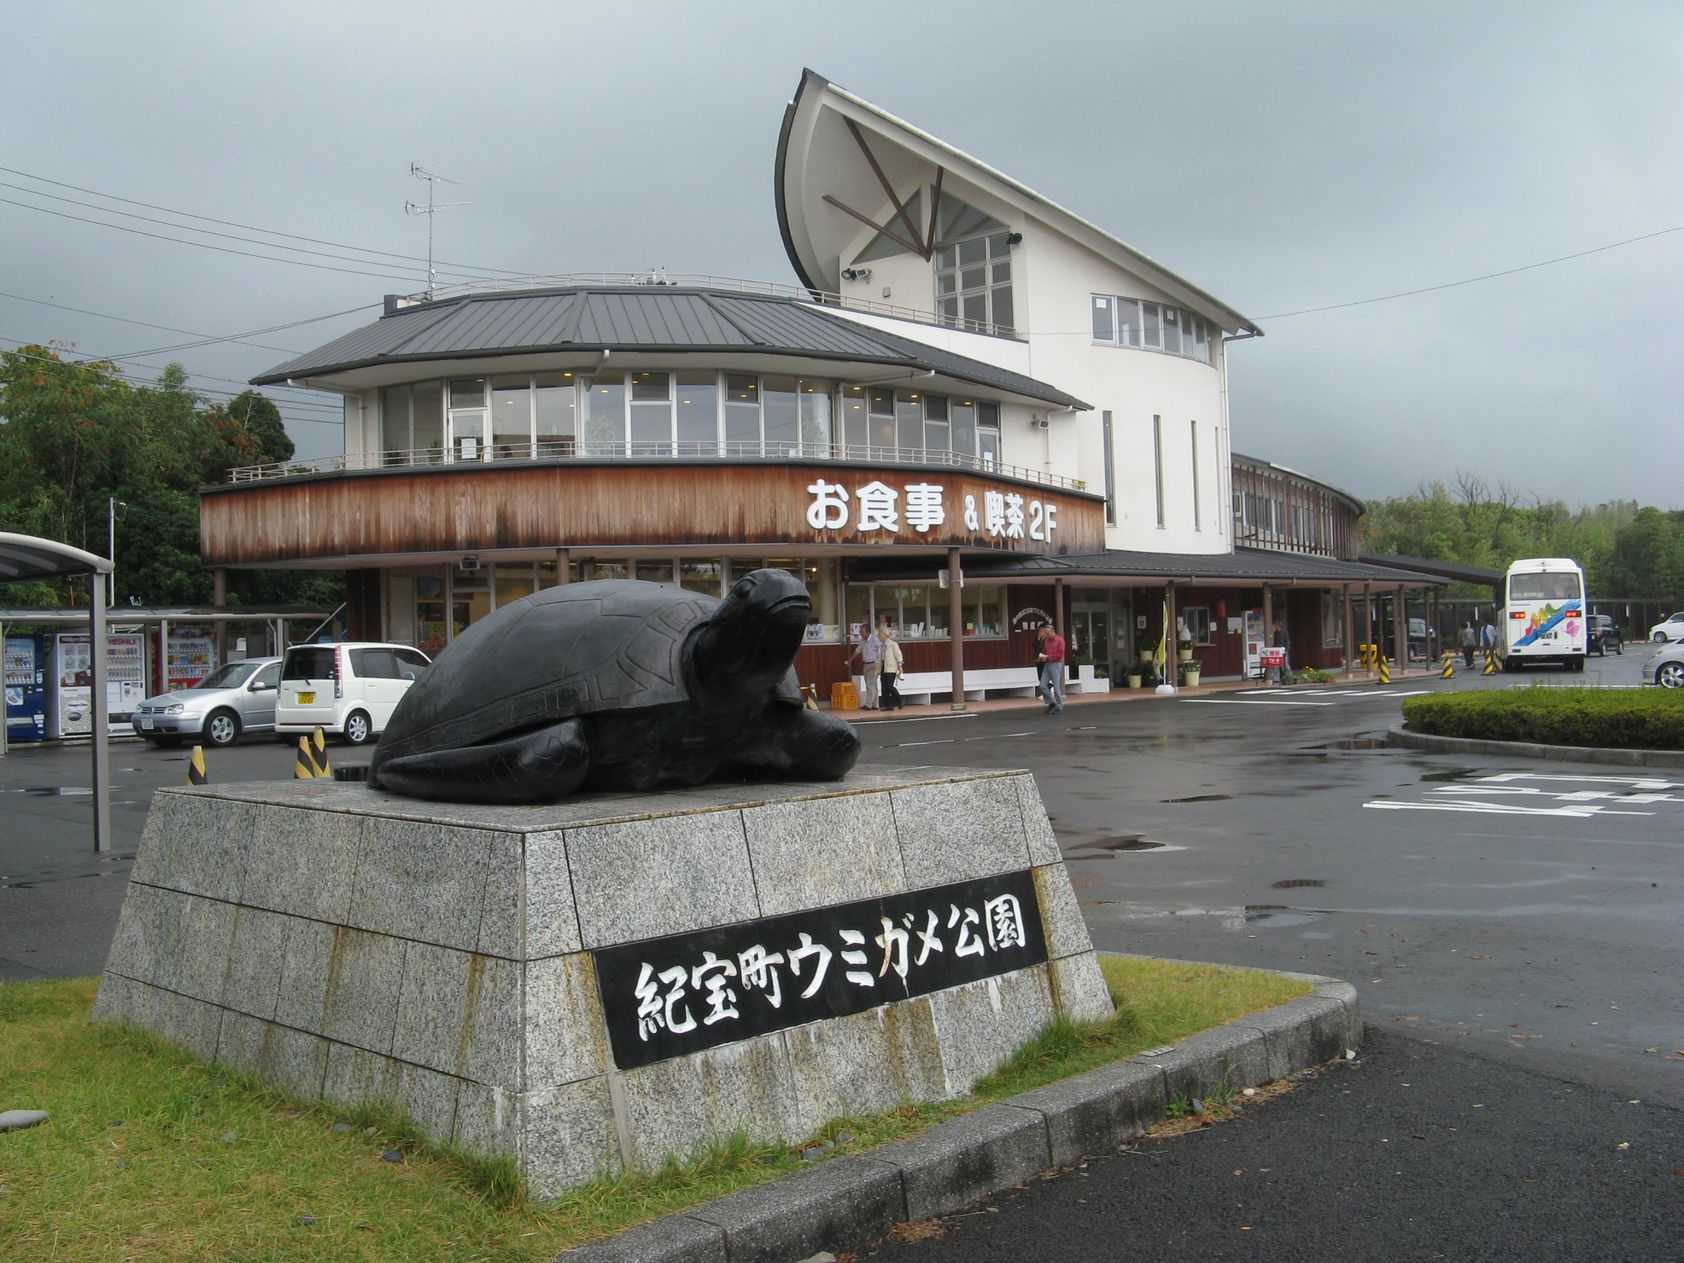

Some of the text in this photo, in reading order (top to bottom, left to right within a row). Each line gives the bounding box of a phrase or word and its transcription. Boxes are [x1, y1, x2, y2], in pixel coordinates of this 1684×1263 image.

[806, 478, 1057, 543] お食事 & 喫茶 2F
[635, 893, 1027, 1042] 紀宝町ウミガメ公園
